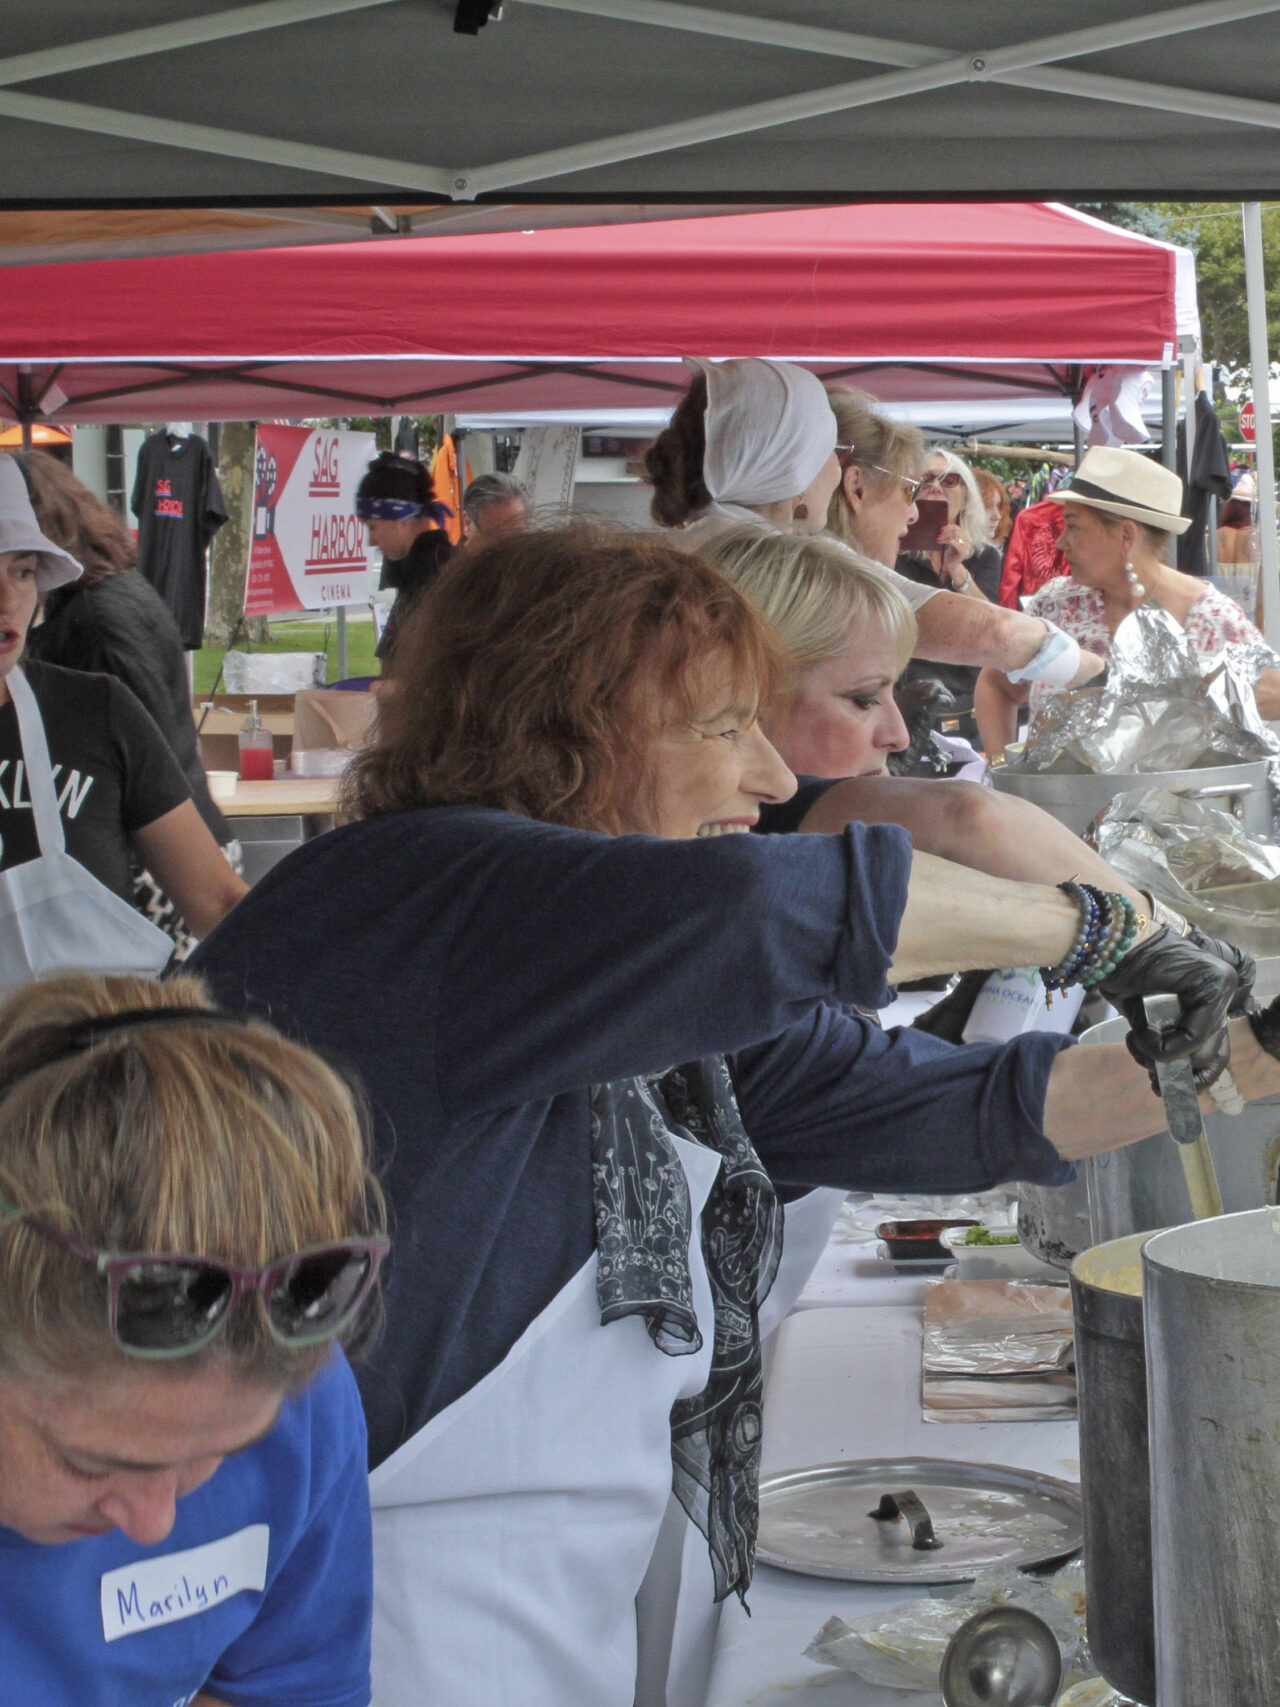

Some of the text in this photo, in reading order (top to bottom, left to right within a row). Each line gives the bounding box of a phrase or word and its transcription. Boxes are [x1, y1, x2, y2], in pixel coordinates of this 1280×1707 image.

[1241, 413, 1255, 429] STO
[313, 436, 339, 483] SAG
[311, 514, 365, 560] HARBOR
[321, 583, 351, 601] CINEMA
[117, 1574, 228, 1625] Marilyn
